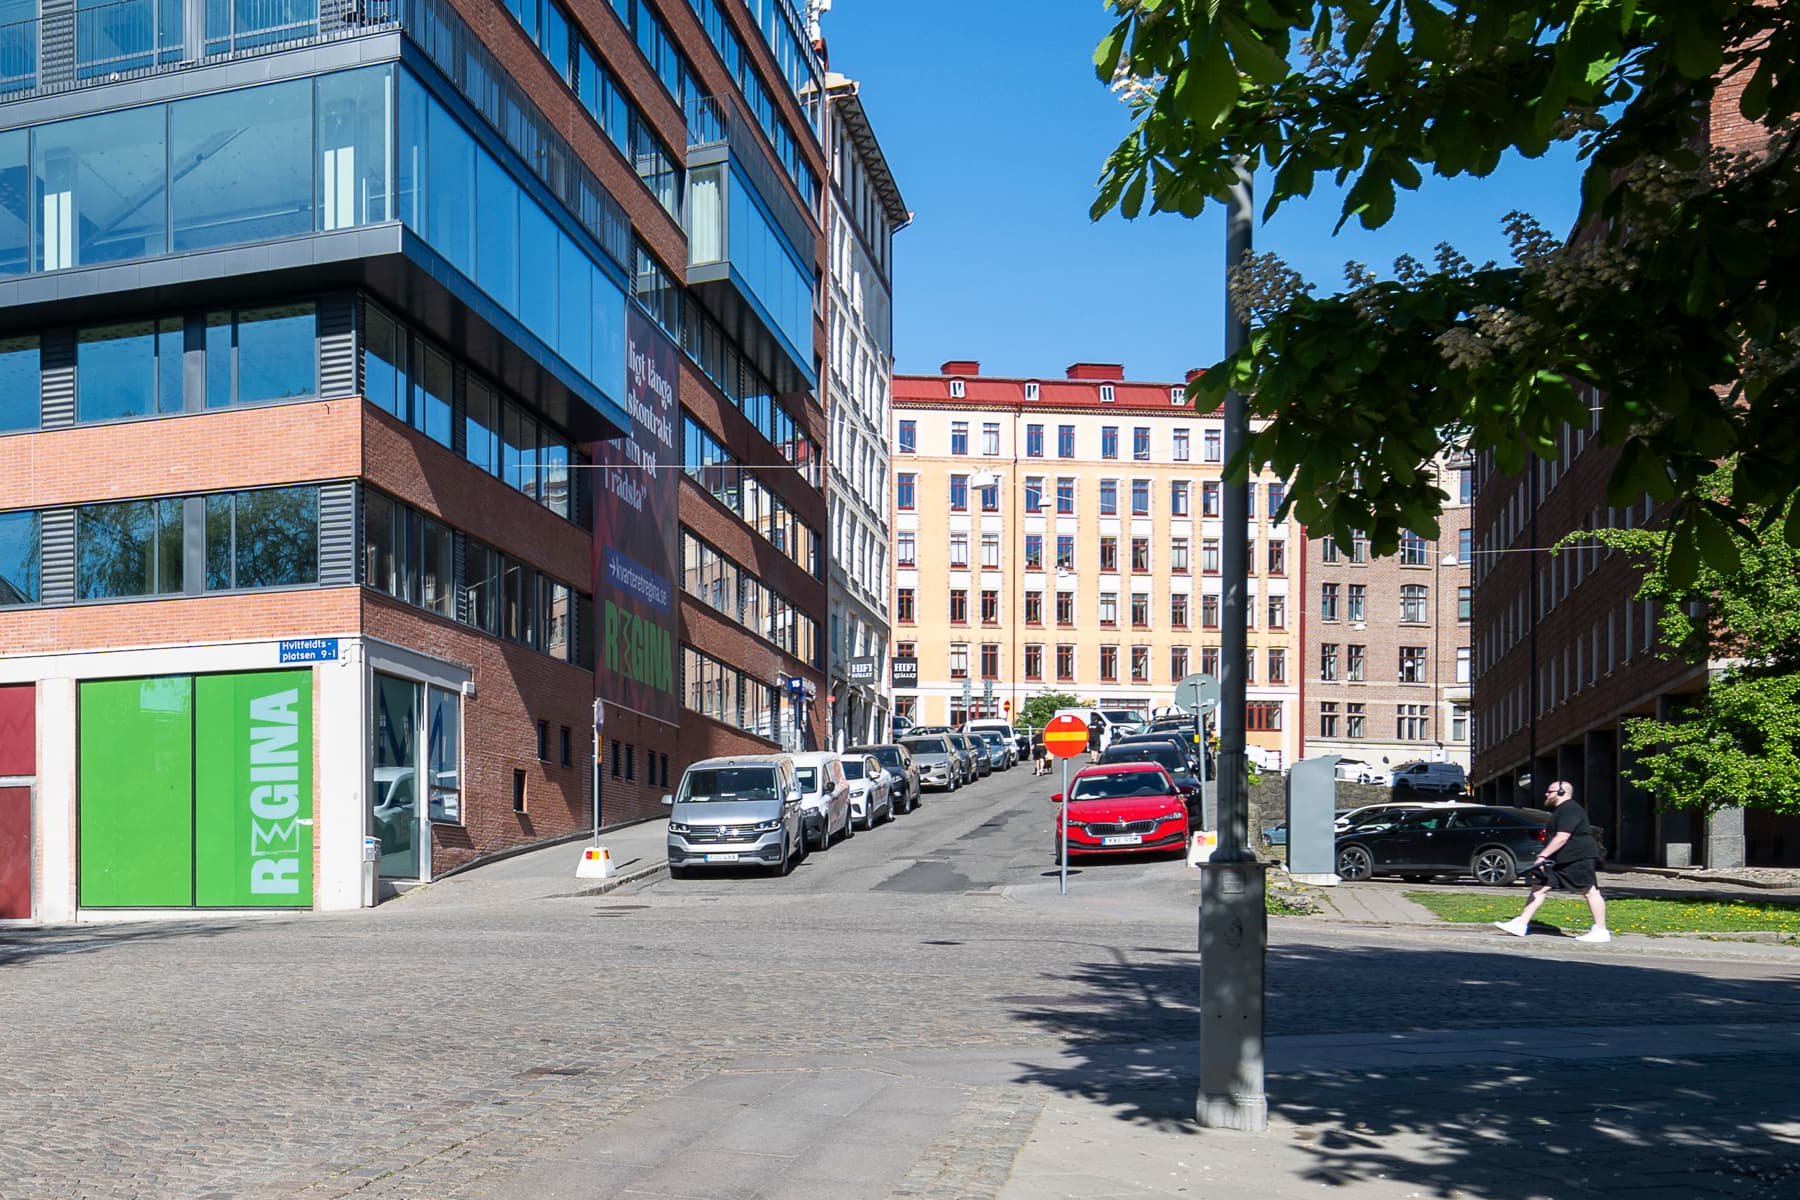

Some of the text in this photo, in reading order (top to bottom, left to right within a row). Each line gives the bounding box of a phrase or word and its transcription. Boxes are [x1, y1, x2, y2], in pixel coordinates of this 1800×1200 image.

[647, 357, 673, 411] långa
[625, 431, 657, 479] sin rot
[616, 556, 668, 607] kvarteretregina.se
[282, 650, 336, 662] platsen 9-1
[852, 664, 872, 672] HIFI
[894, 663, 916, 672] HIFI
